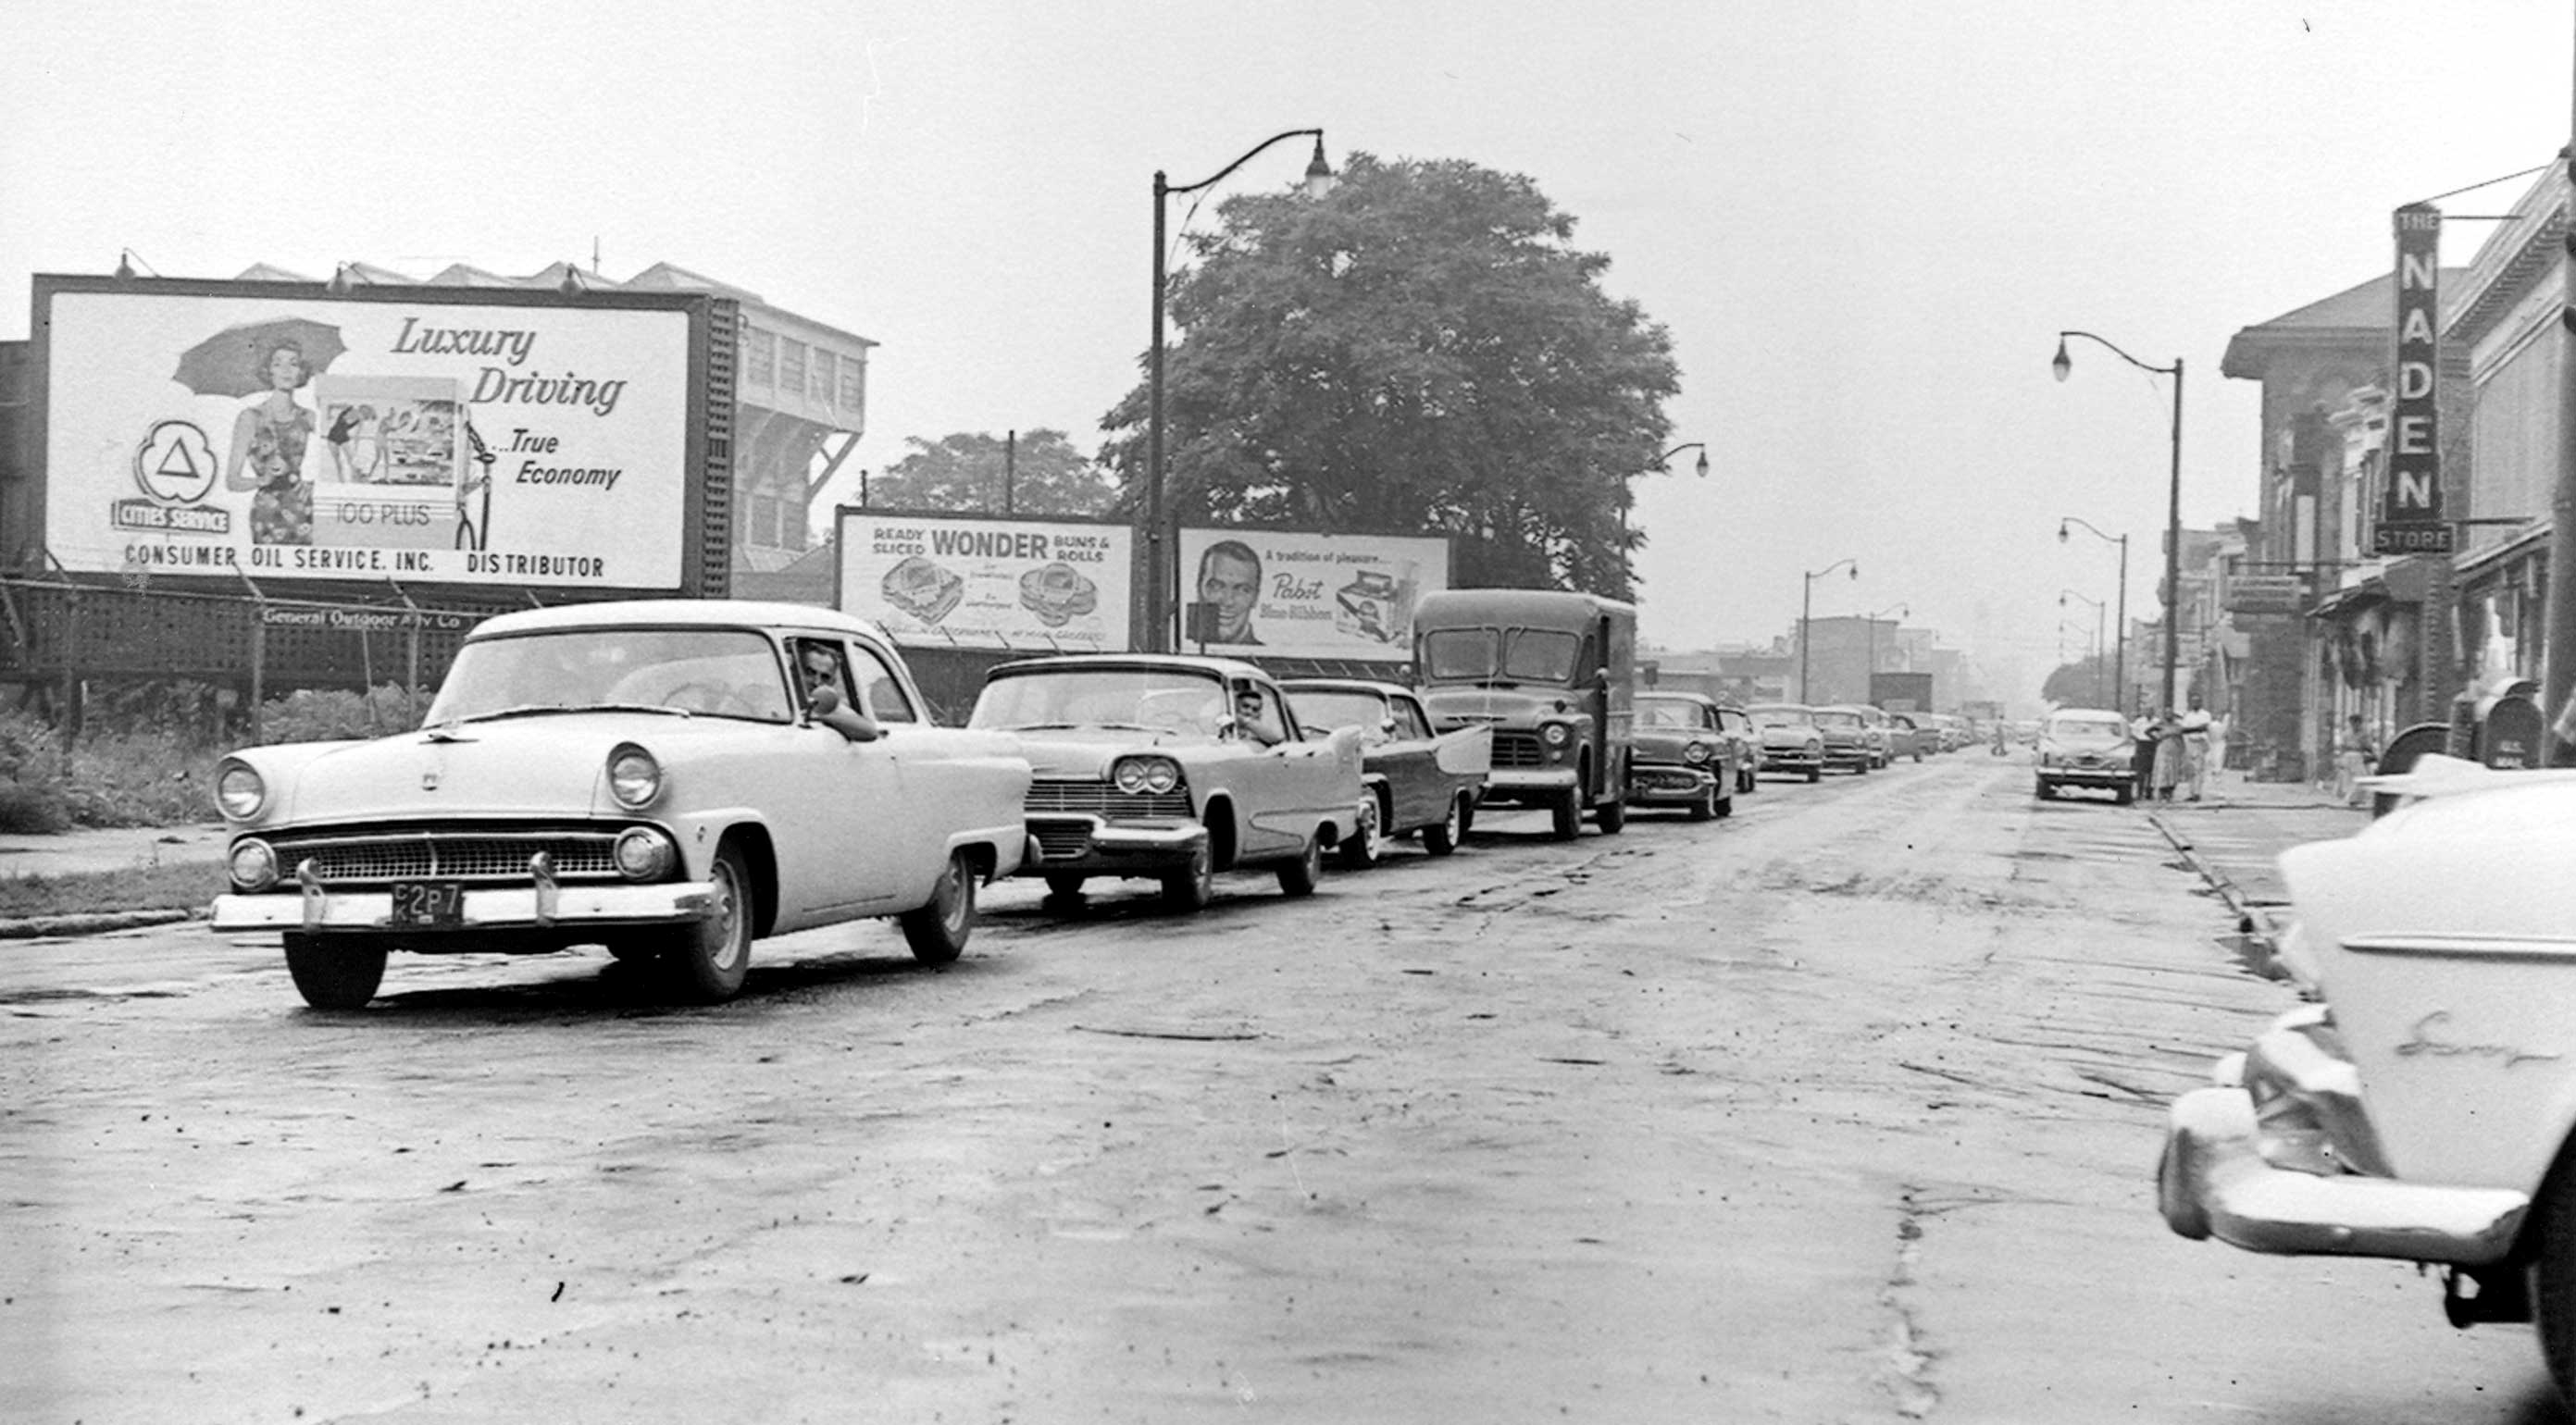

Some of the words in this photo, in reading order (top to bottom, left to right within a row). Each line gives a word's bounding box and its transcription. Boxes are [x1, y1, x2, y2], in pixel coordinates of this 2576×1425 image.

[2399, 212, 2439, 230] THE
[390, 316, 536, 366] Luxury
[469, 366, 628, 416] Driving
[2397, 253, 2433, 508] NADEN
[516, 461, 622, 490] Economy
[119, 505, 168, 527] CITIES
[170, 509, 229, 532] SERVICE
[336, 501, 372, 525] 100
[380, 502, 430, 527] PLUS
[874, 528, 925, 541] READY
[931, 529, 1049, 559] WONDER
[1053, 535, 1097, 549] BUNS
[1099, 537, 1110, 549] &
[2376, 529, 2449, 548] STORE
[124, 544, 236, 567] CONSUMER
[252, 547, 283, 568] OIL
[467, 553, 604, 577] DISTRIBUTOR
[873, 543, 926, 556] SLICED
[1057, 551, 1105, 562] ROLLS
[1265, 550, 1273, 560] A
[1272, 572, 1325, 601] Pabst
[263, 608, 325, 626] General
[437, 616, 461, 629] Co
[410, 884, 458, 916] 2P7
